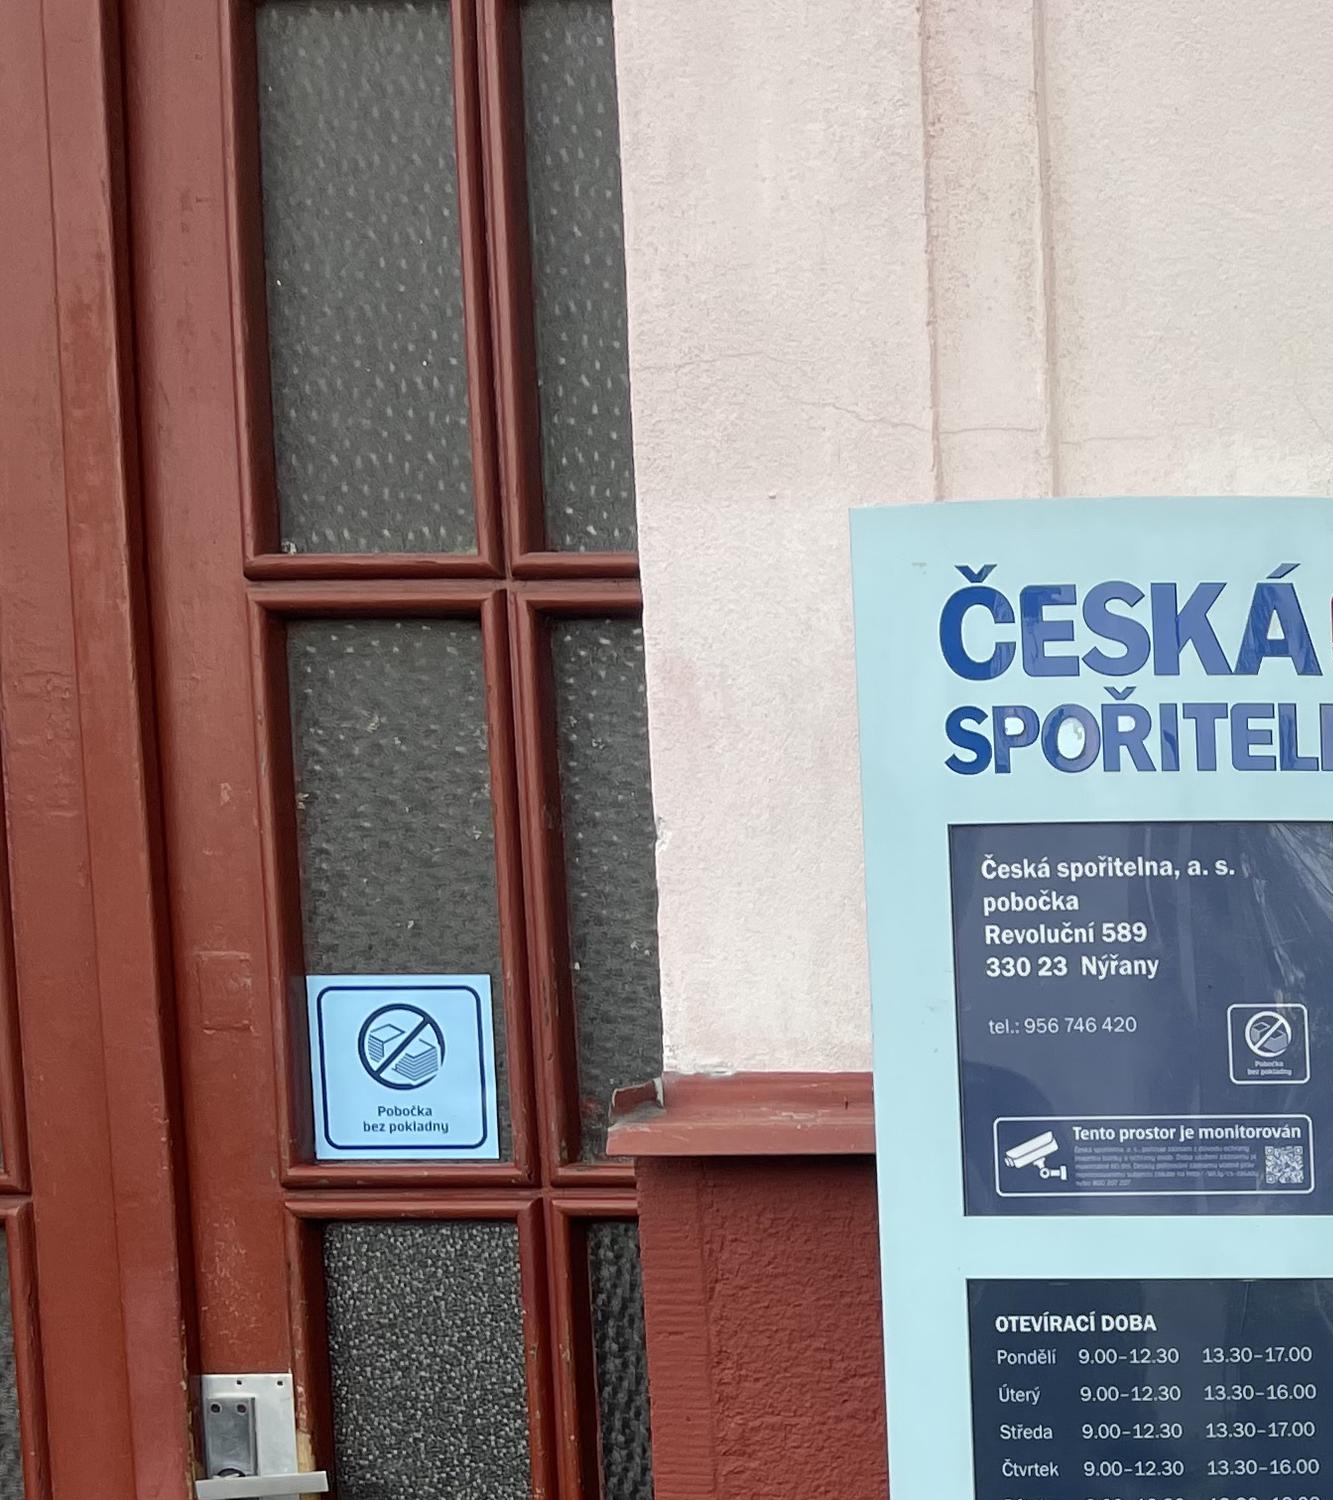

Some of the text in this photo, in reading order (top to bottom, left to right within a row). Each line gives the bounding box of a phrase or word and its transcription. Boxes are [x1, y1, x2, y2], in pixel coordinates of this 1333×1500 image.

[938, 562, 1323, 681] ČESKÁ
[981, 854, 1235, 881] Česká spořitelna, a. s.
[984, 890, 1079, 916] pobočka
[985, 921, 1147, 944] Revoluční 589
[986, 954, 1159, 980] 330 23 Nýřany
[989, 1017, 1137, 1034] tel.: 956 746 420
[378, 1105, 432, 1116] Pobočka
[363, 1121, 448, 1134] bez pokladny
[1072, 1124, 1301, 1142] Tento prostor je monitorován
[995, 1311, 1156, 1333] OTEVÍRACÍ DOBA
[997, 1349, 1056, 1365] Pondělí
[998, 1384, 1040, 1405] Úterý
[999, 1424, 1053, 1440] Středa
[1002, 1458, 1059, 1478] Čtvrtek
